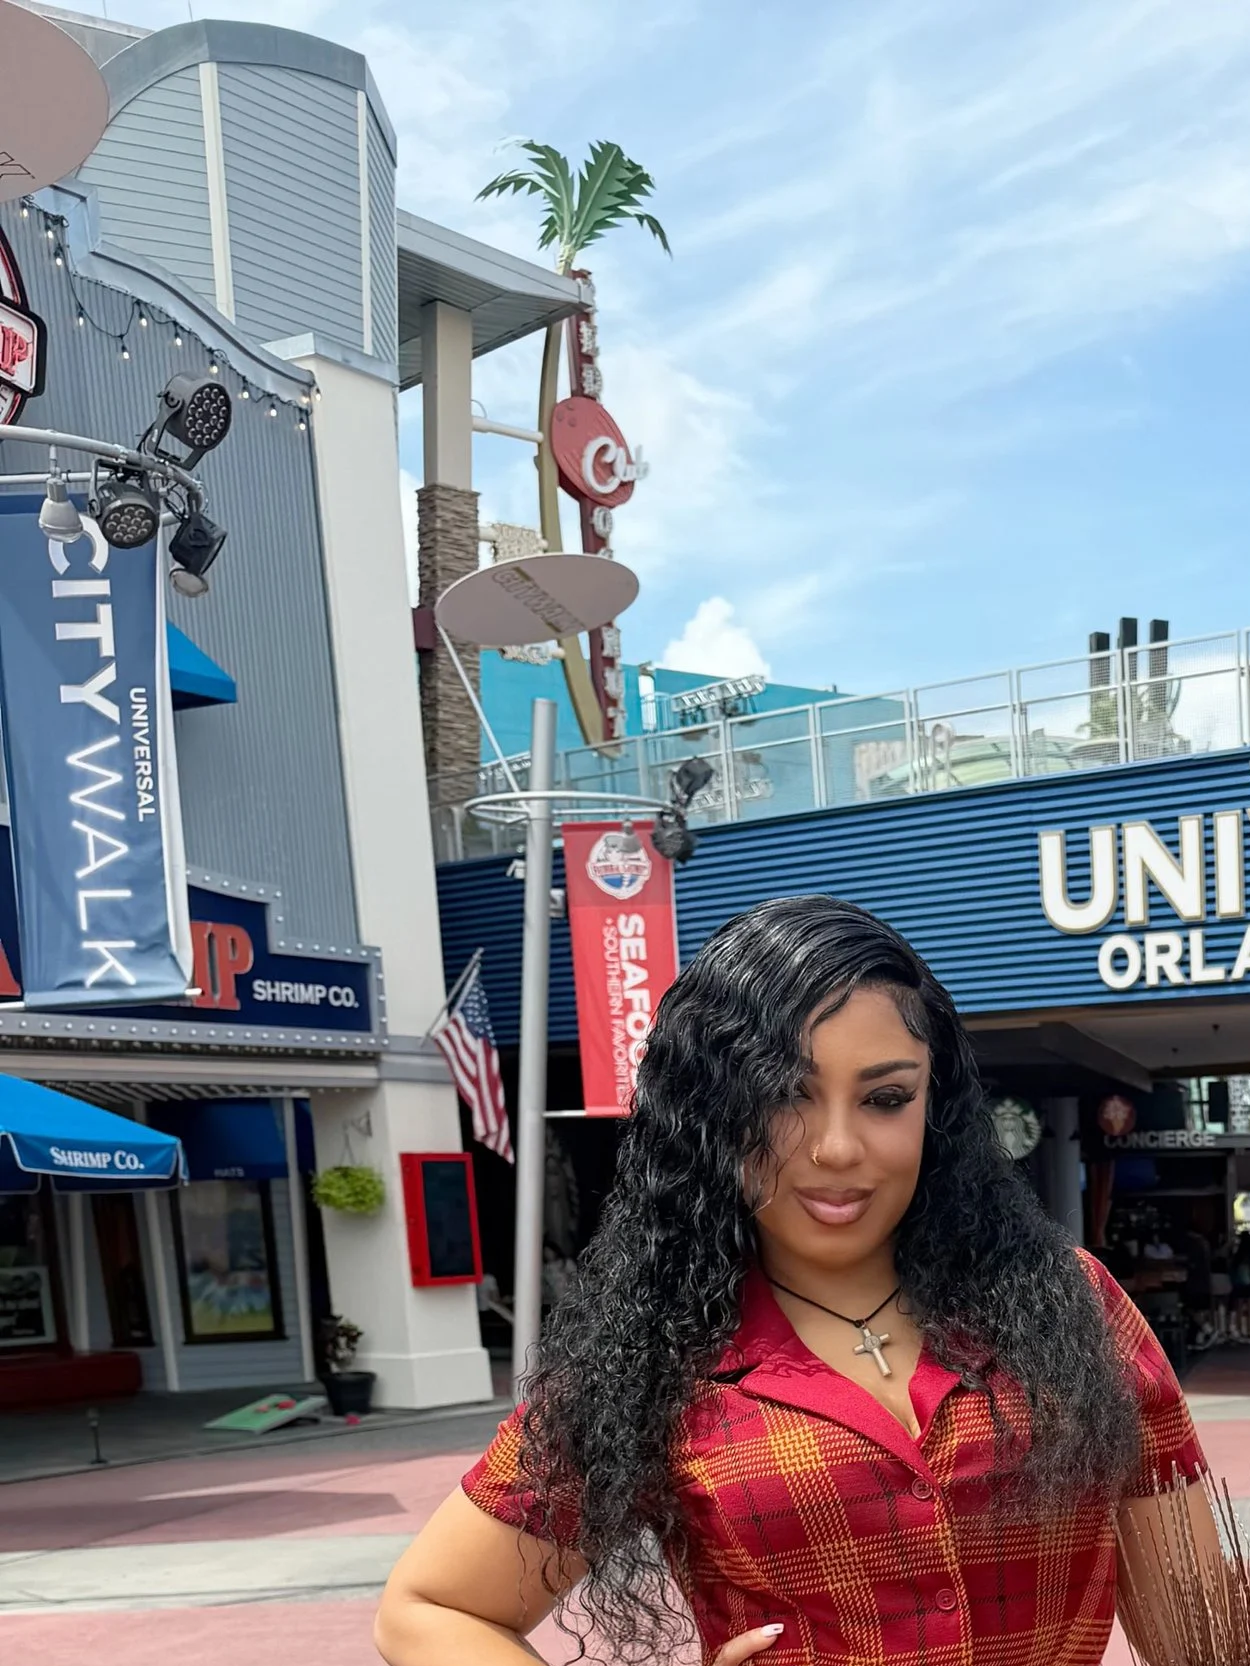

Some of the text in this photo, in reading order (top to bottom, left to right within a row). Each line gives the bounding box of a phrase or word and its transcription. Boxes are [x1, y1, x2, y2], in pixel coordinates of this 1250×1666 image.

[129, 687, 157, 823] UNIVERSAL
[252, 979, 360, 1009] SHRIMP CO.
[602, 926, 624, 1016] SOUTHERN
[1104, 1130, 1216, 1148] CONCIERGE
